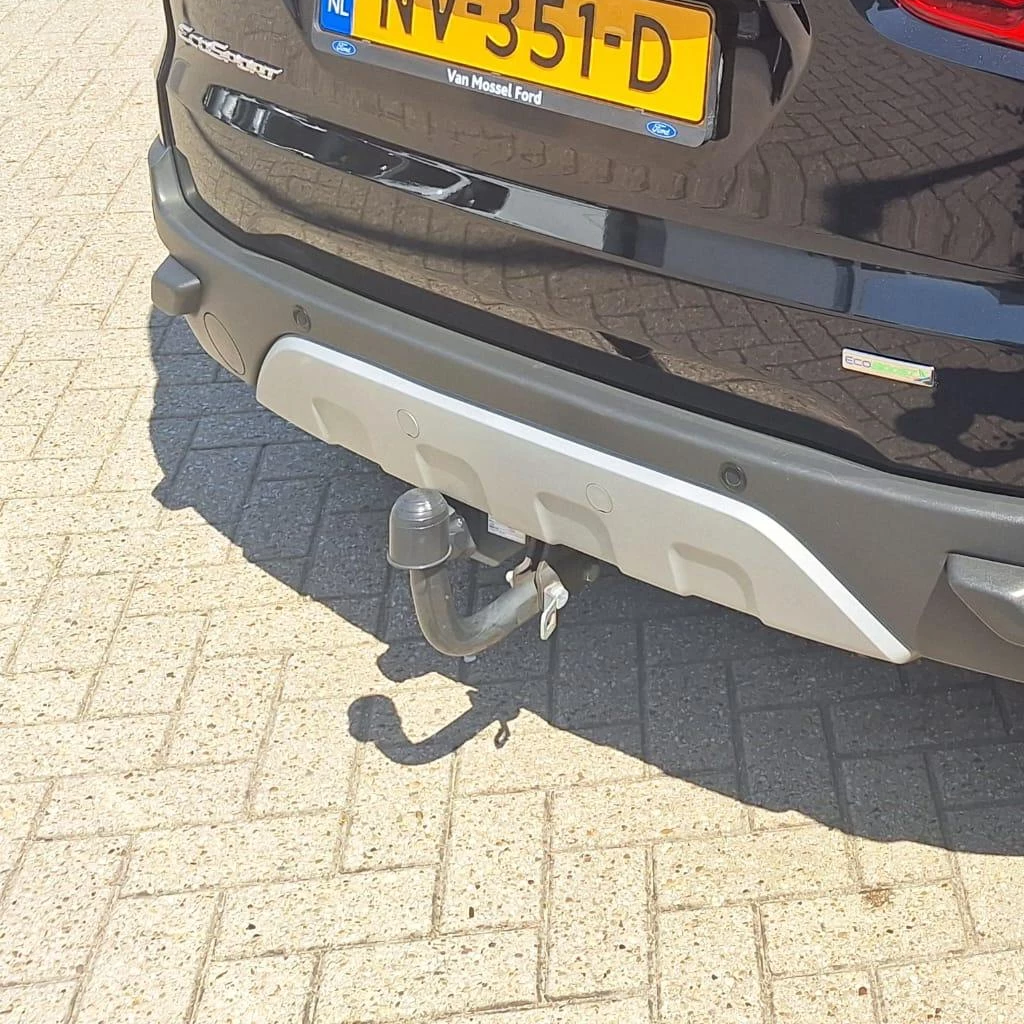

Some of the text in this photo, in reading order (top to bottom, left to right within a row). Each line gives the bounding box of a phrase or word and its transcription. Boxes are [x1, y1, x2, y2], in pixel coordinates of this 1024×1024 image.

[447, 68, 543, 105] Van Mossel Ford
